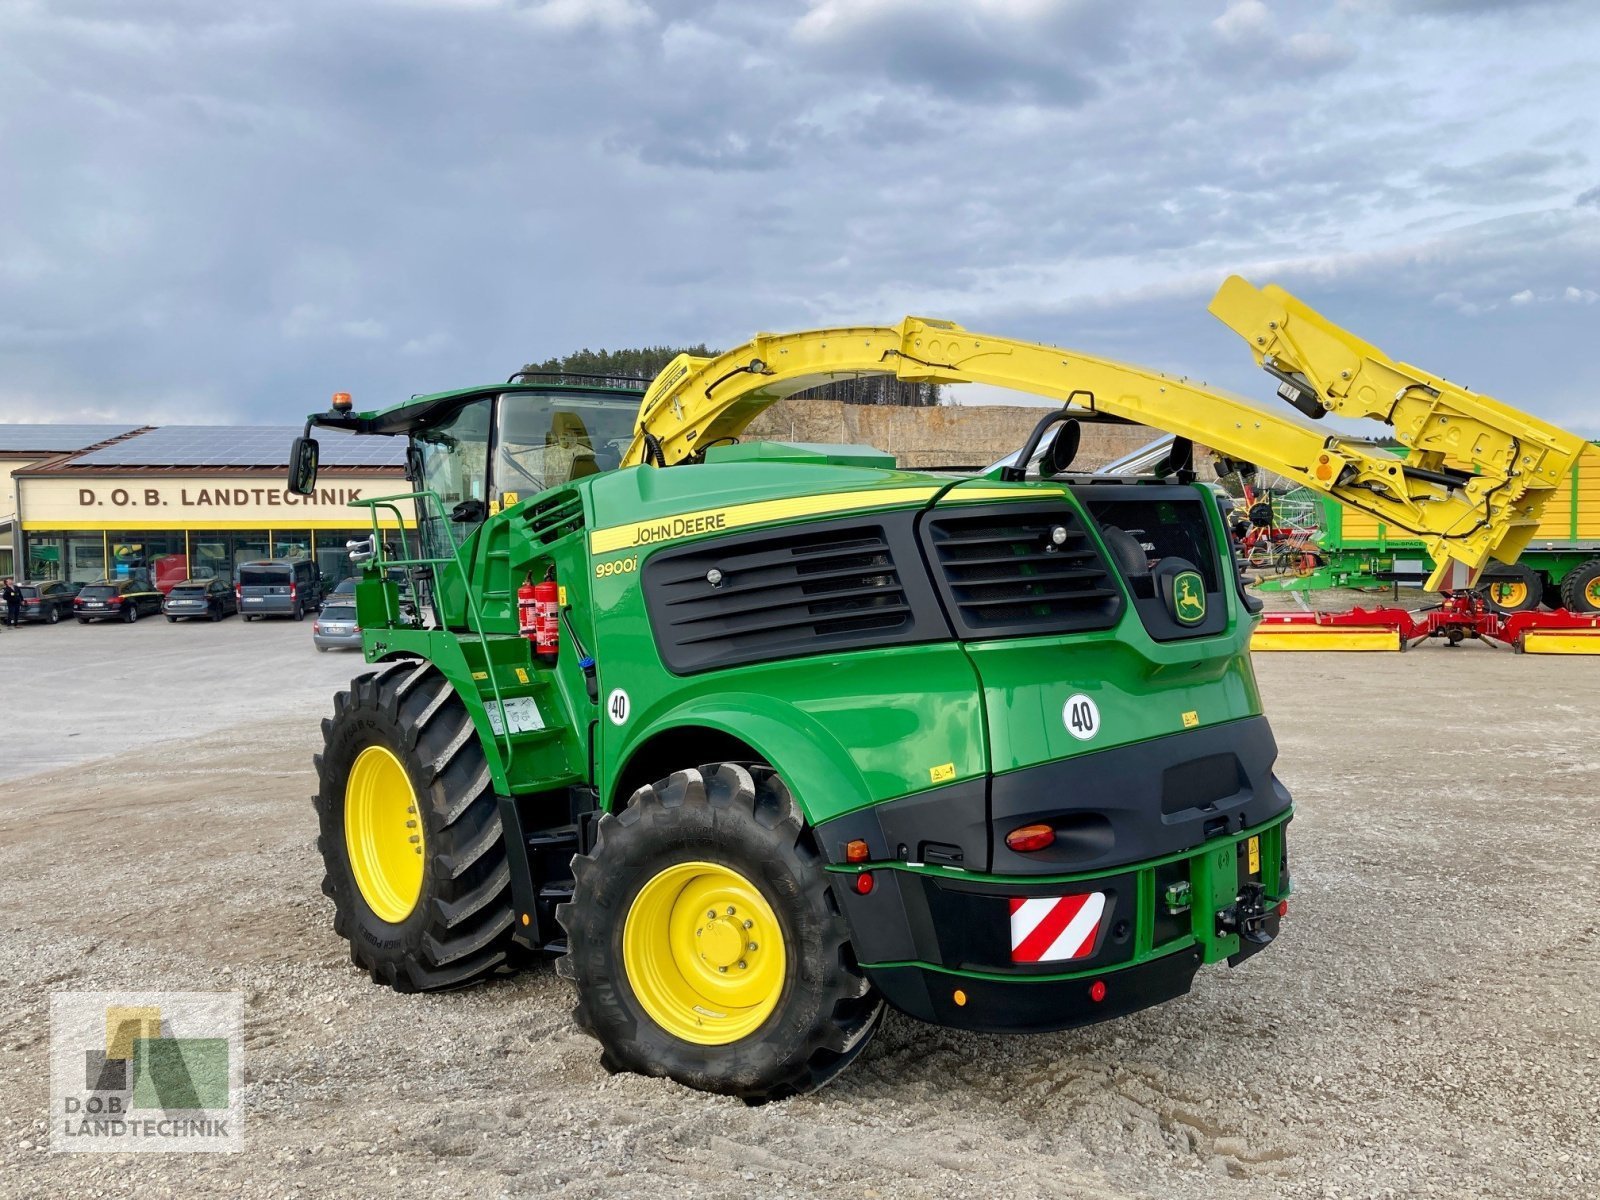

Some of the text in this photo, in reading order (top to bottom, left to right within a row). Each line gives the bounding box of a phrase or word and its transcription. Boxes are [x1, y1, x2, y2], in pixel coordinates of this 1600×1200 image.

[181, 488, 362, 506] LANDTECHNIK
[633, 513, 726, 545] JOHN DEERE
[595, 555, 638, 578] 9900i
[612, 695, 625, 719] 40
[1071, 701, 1094, 732] 40
